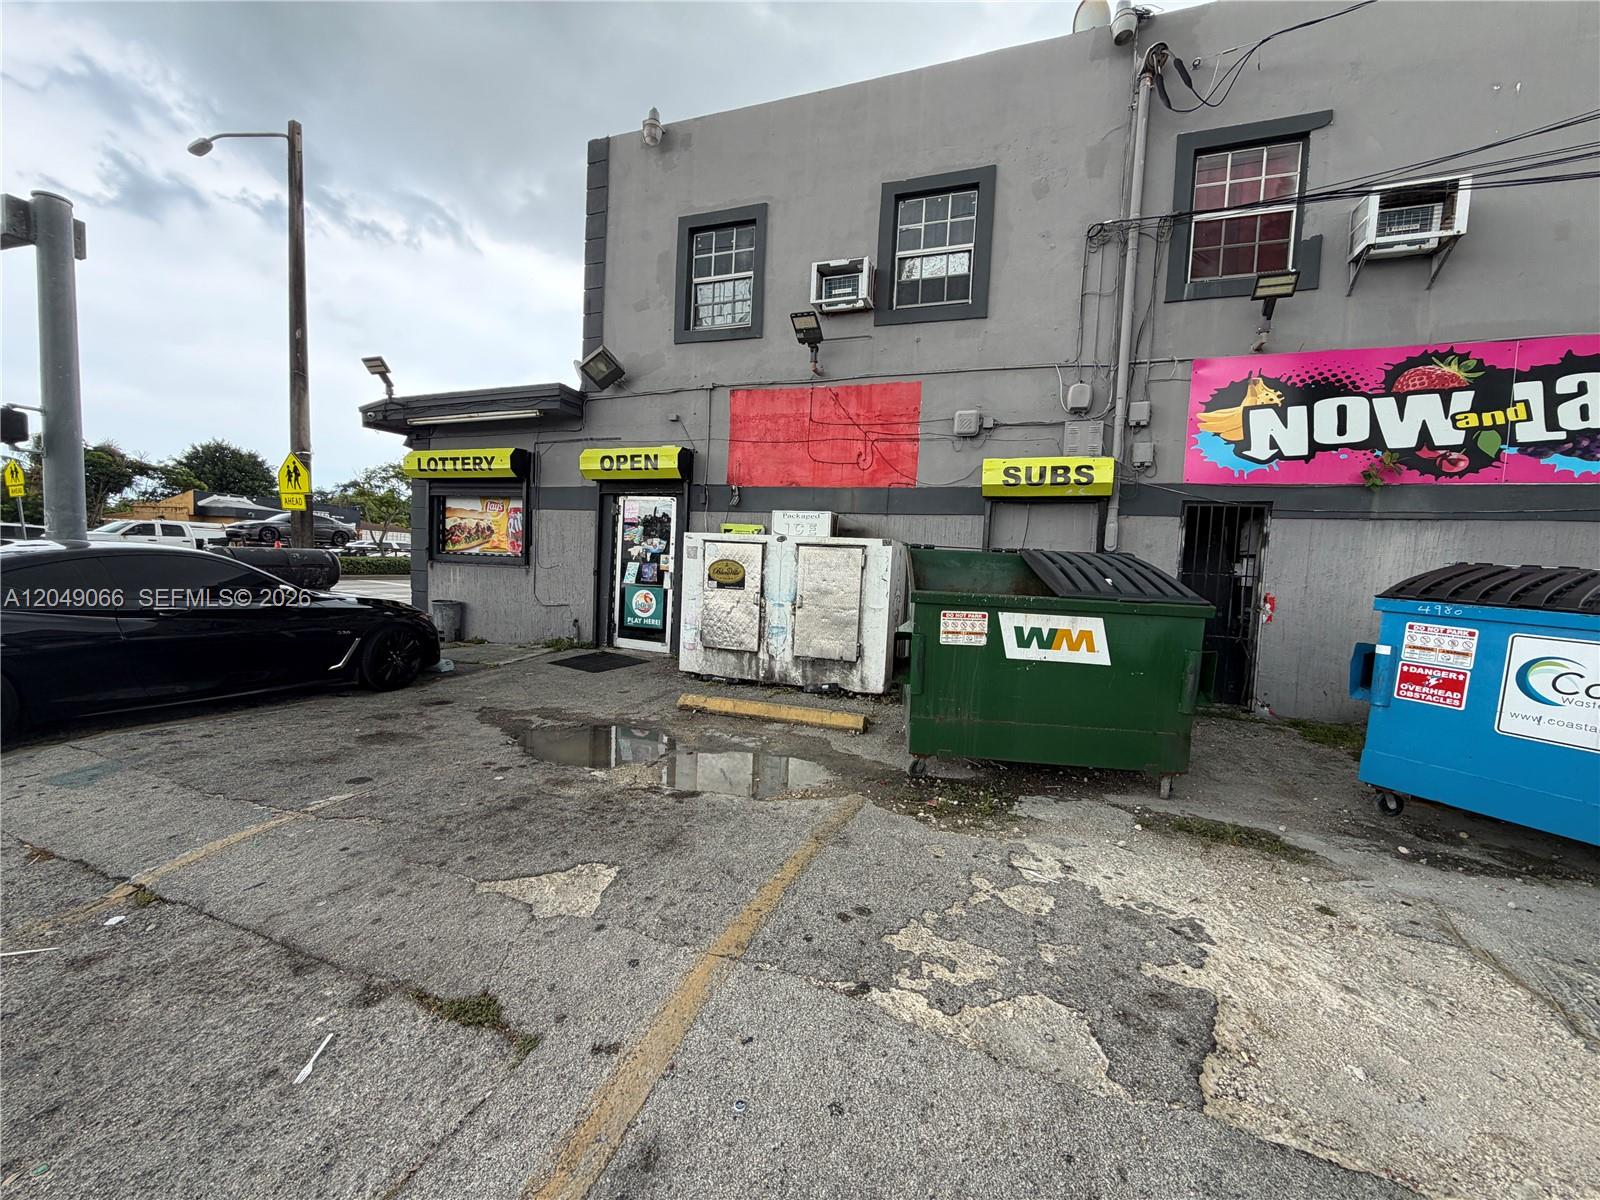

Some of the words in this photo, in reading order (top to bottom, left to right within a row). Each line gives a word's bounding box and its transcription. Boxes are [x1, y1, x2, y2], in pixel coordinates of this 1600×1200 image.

[1243, 391, 1475, 460] NOW
[1454, 402, 1526, 429] and
[417, 455, 495, 472] LOTTERY
[599, 454, 659, 471] OPEN
[1002, 465, 1095, 486] SUBS
[284, 497, 303, 506] AHEAD
[782, 512, 820, 520] Packaged
[785, 522, 818, 535] ICE
[1013, 626, 1096, 653] WM
[1446, 628, 1470, 636] PARK
[1409, 666, 1458, 680] DANGER
[1399, 690, 1460, 706] OBSTACLES
[1400, 683, 1461, 699] OVERHEAD
